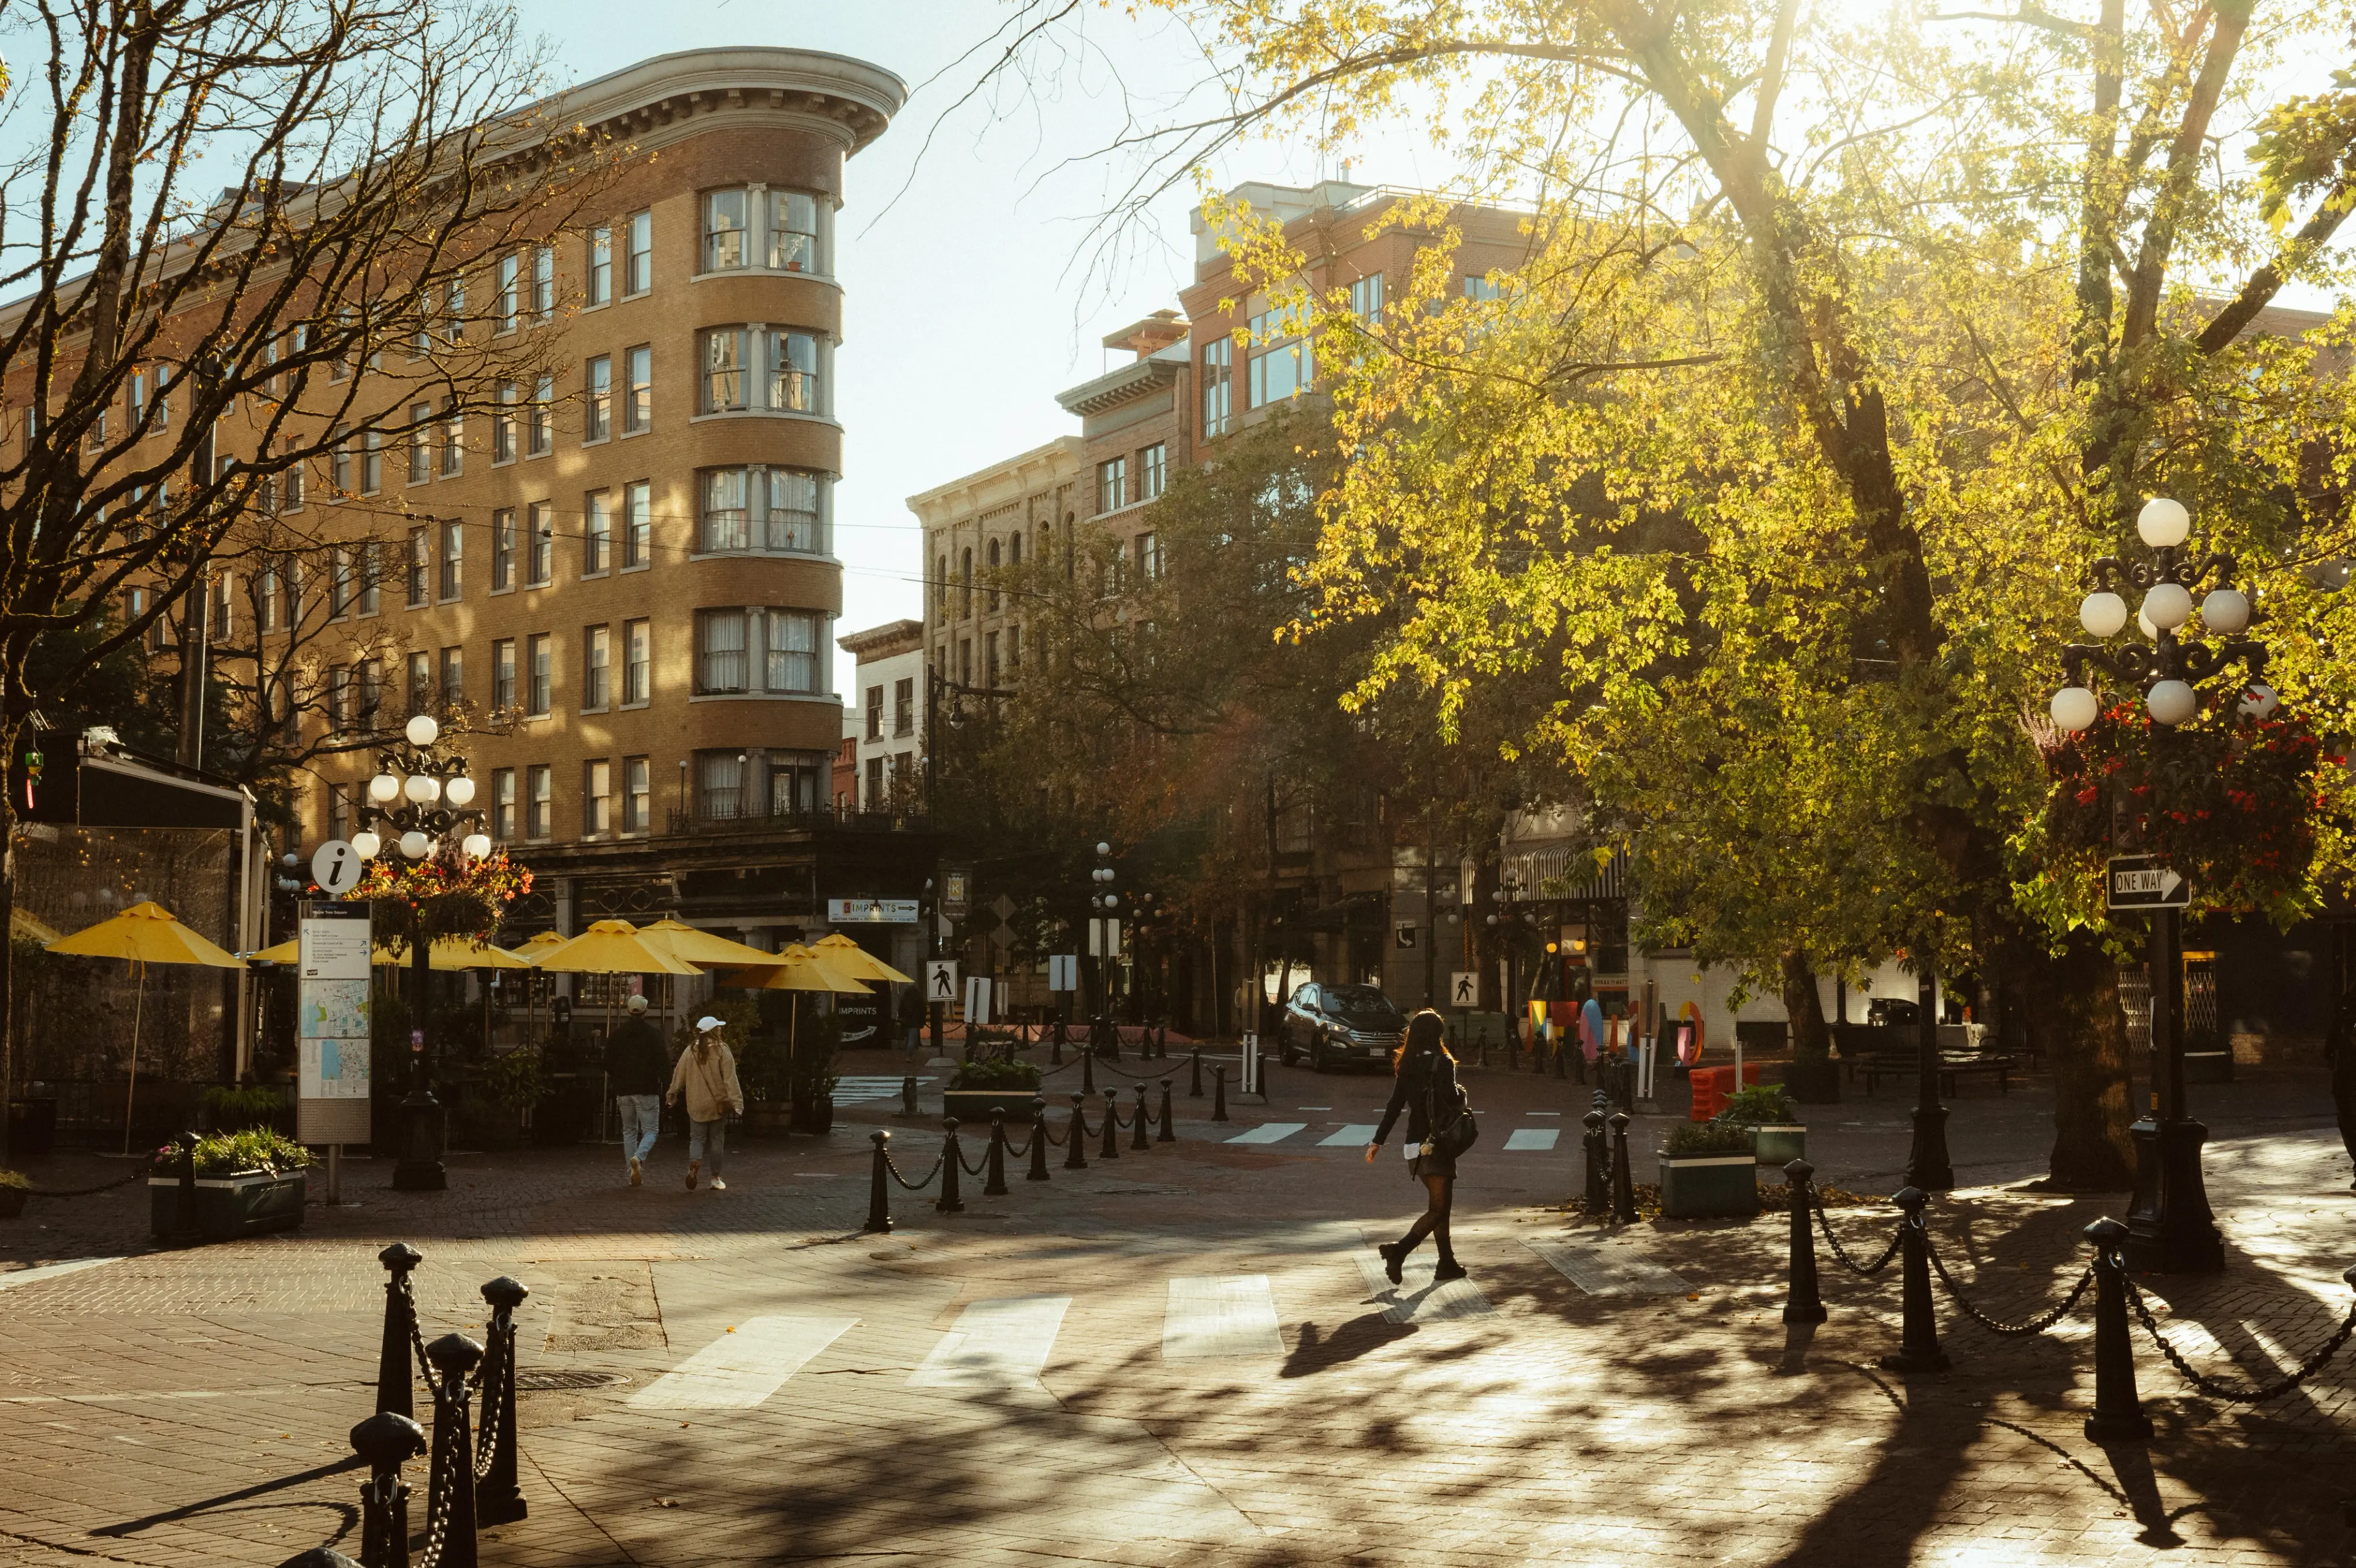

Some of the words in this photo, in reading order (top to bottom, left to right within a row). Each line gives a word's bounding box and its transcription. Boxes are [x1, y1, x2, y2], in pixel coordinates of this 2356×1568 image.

[2117, 874, 2136, 891] ONE
[2141, 872, 2162, 890] WAY
[952, 885, 960, 893] K
